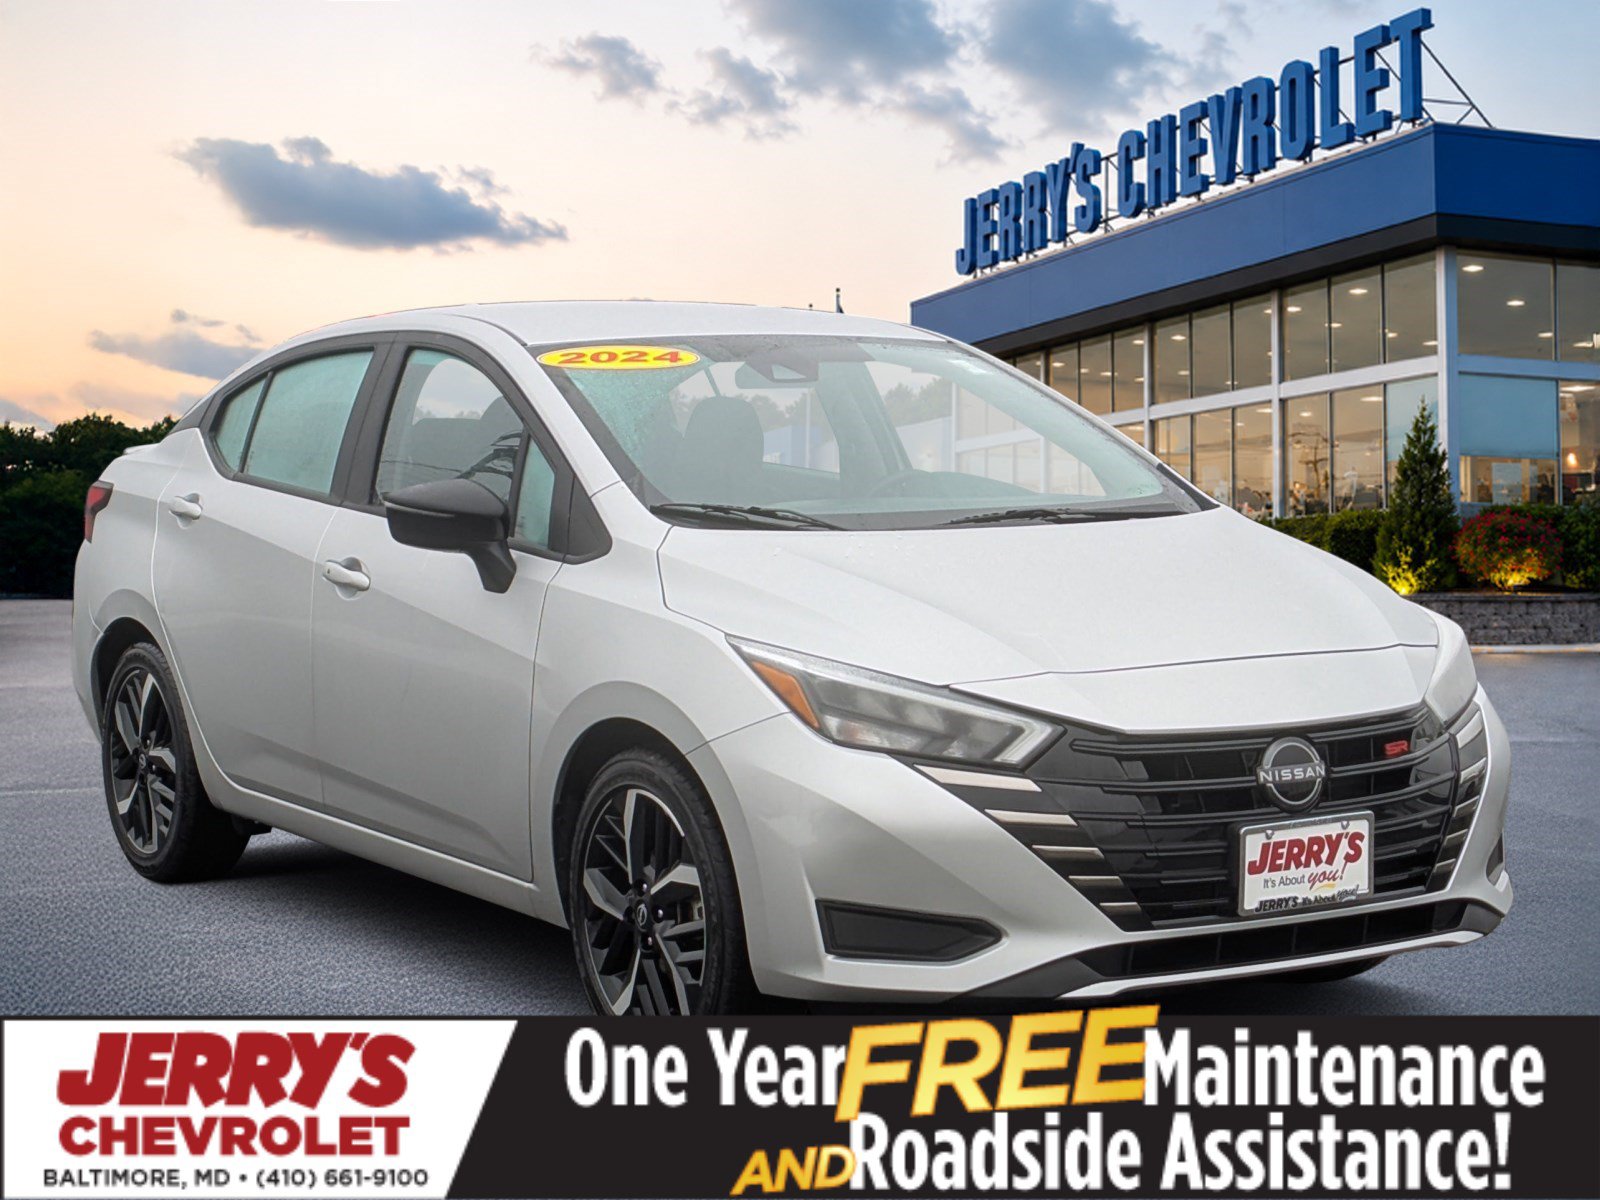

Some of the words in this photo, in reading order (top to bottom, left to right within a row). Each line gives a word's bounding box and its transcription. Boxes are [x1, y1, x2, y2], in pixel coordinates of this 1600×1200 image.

[955, 141, 1103, 276] JERRY'S
[1117, 8, 1433, 218] CHEVROLET
[558, 351, 683, 364] 2024
[1385, 741, 1409, 756] SR
[1260, 765, 1326, 783] NISSAN
[1247, 831, 1366, 876] JERRY'S
[1263, 877, 1277, 889] It's
[1278, 874, 1306, 887] About
[1308, 862, 1347, 891] you!
[1255, 896, 1299, 913] JERRY'S
